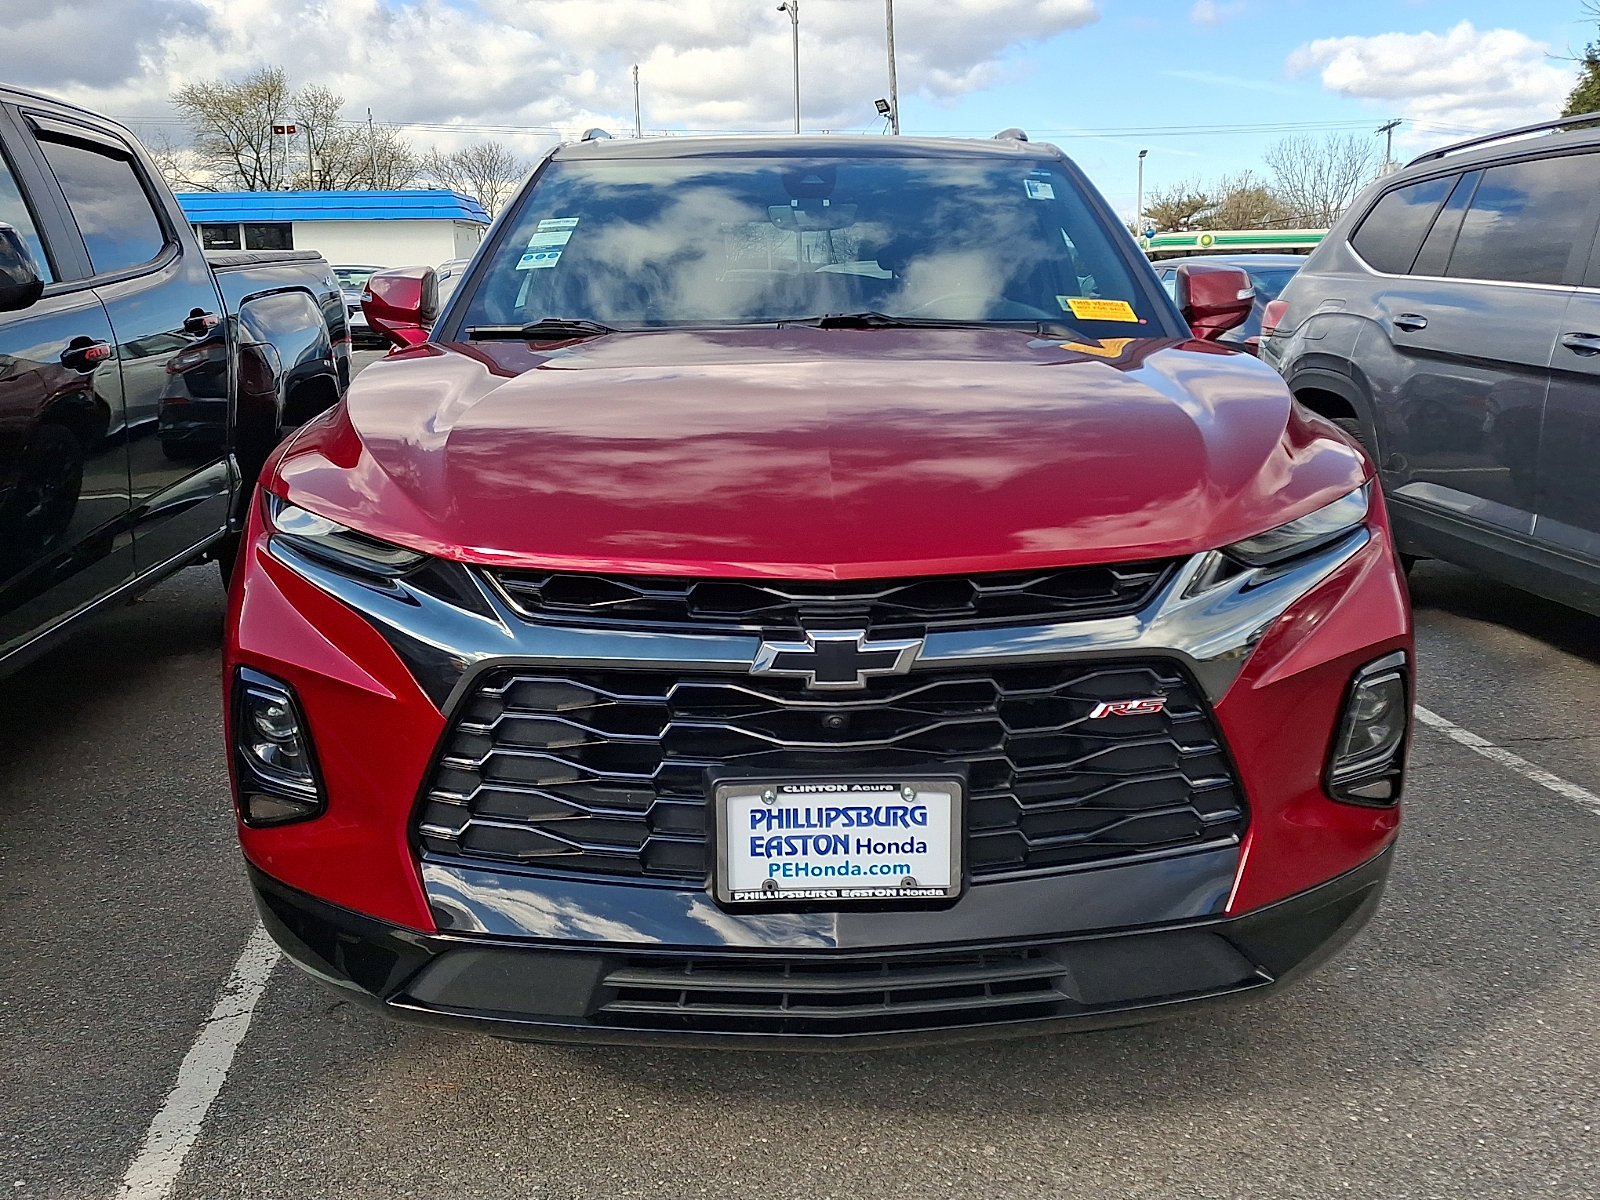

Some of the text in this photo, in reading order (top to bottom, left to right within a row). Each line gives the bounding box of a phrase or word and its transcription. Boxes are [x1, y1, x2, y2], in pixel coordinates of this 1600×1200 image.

[1089, 698, 1167, 719] RS
[783, 784, 894, 793] CLINTON Acura
[750, 806, 927, 832] PHILLIPSBURG
[750, 834, 927, 859] EASTON Honda
[769, 860, 911, 878] PEHonda.com
[734, 888, 944, 900] PHILLIPSBURG EASTON Honda
